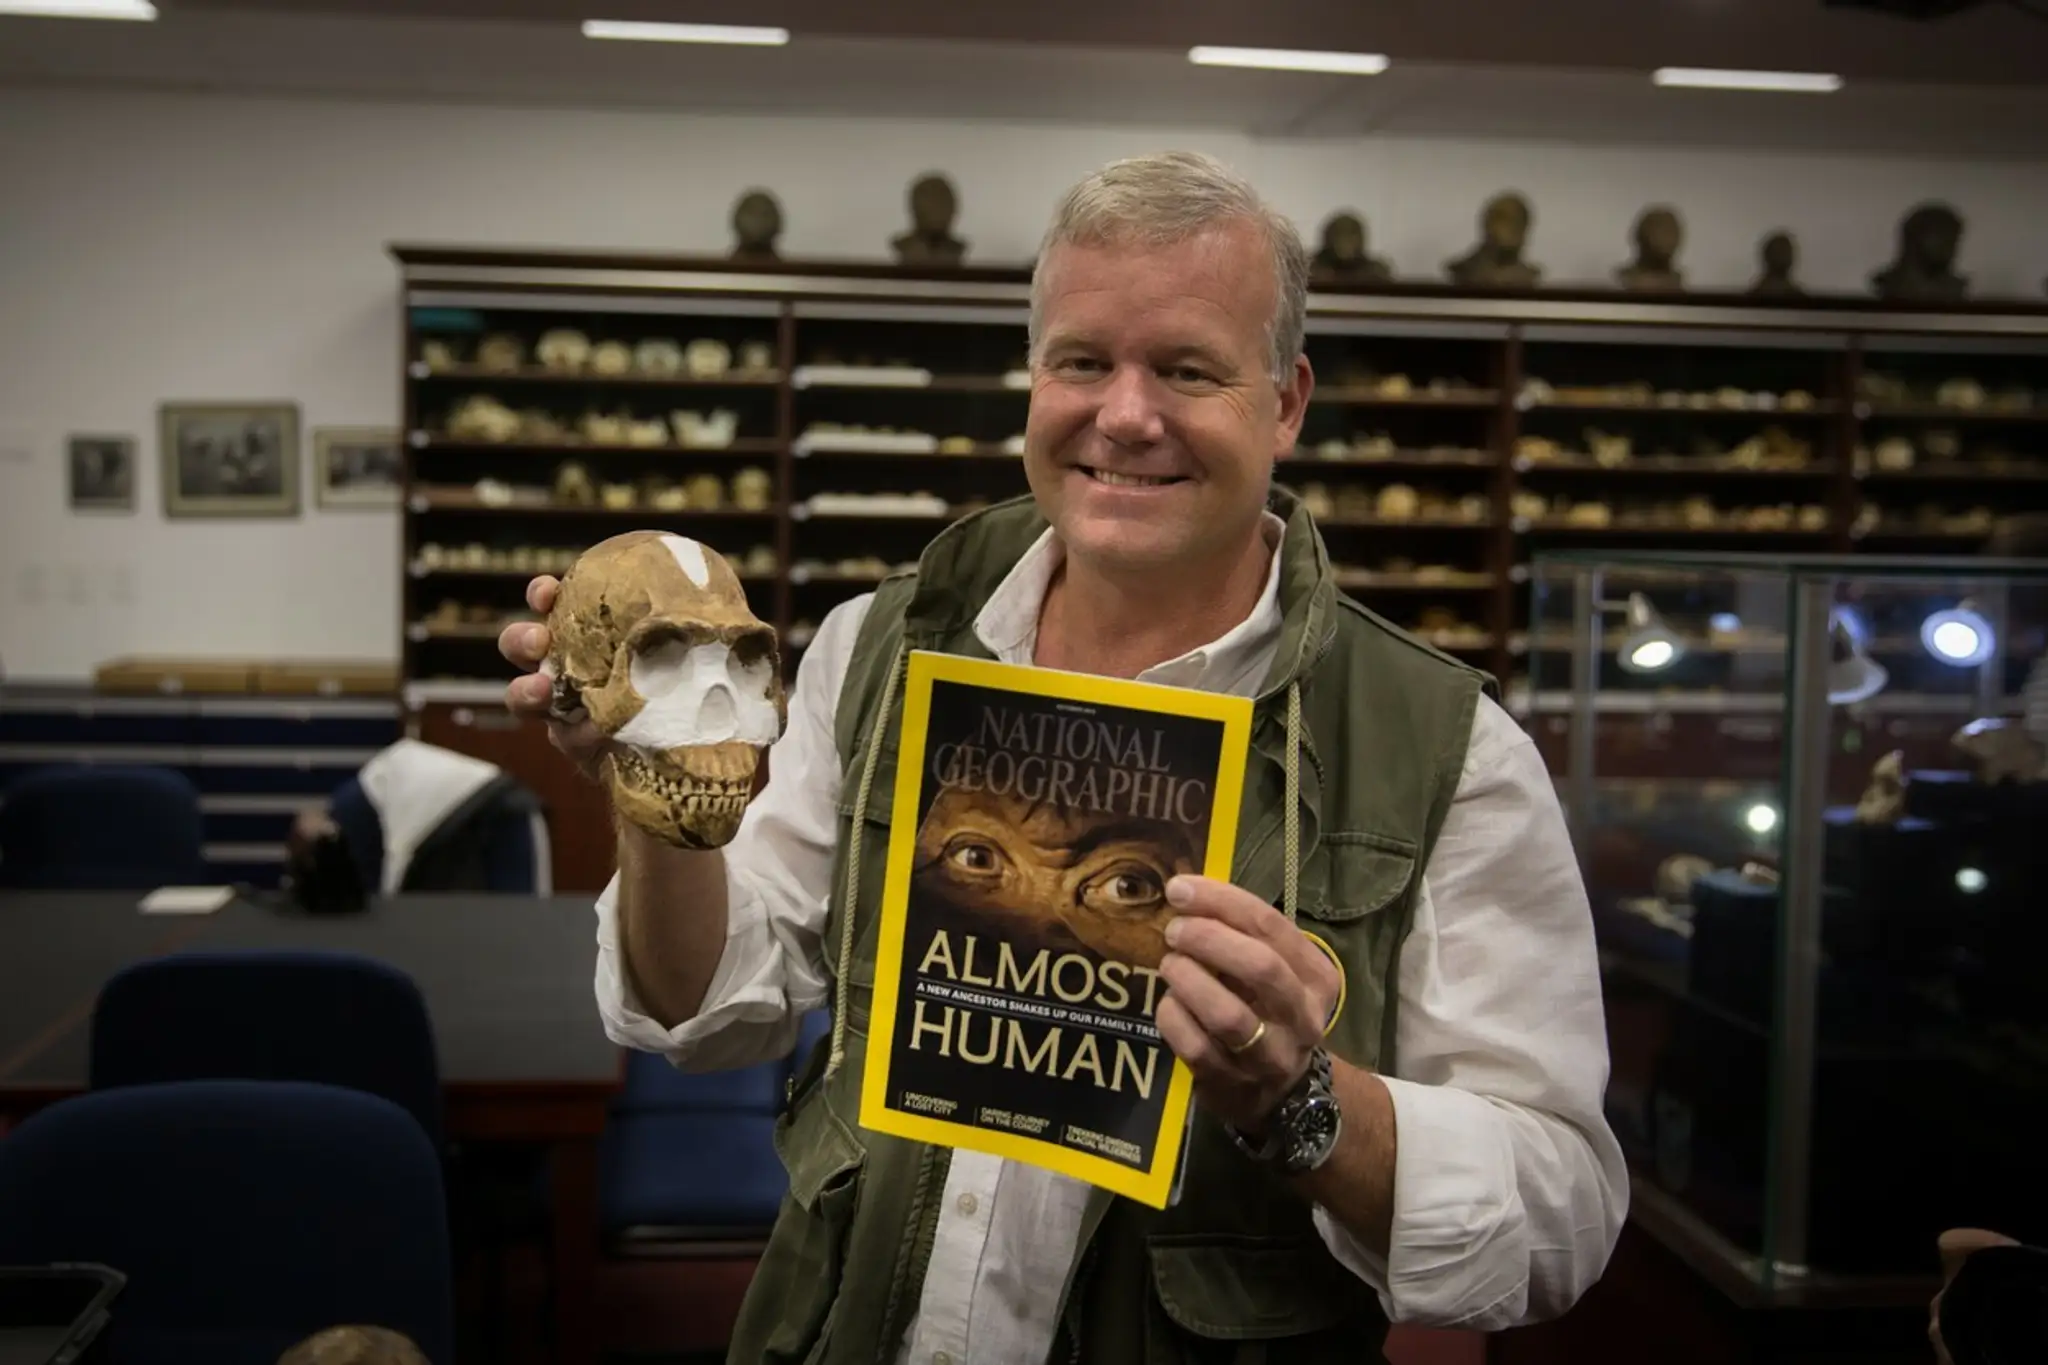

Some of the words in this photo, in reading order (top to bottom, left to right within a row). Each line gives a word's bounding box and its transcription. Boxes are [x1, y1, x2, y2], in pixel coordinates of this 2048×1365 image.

[980, 705, 1171, 772] NATIONAL
[932, 743, 1206, 824] GEOGRAPHIC
[917, 929, 1161, 1017] ALMOST
[917, 983, 926, 992] A
[927, 984, 950, 997] NEW
[952, 989, 1007, 1009] ANCESTOR
[1009, 1000, 1051, 1017] SHAKES
[1052, 1008, 1068, 1021] UP
[1069, 1012, 1092, 1025] OUR
[1094, 1017, 1133, 1034] FAMILY
[909, 1000, 1159, 1099] HUMAN
